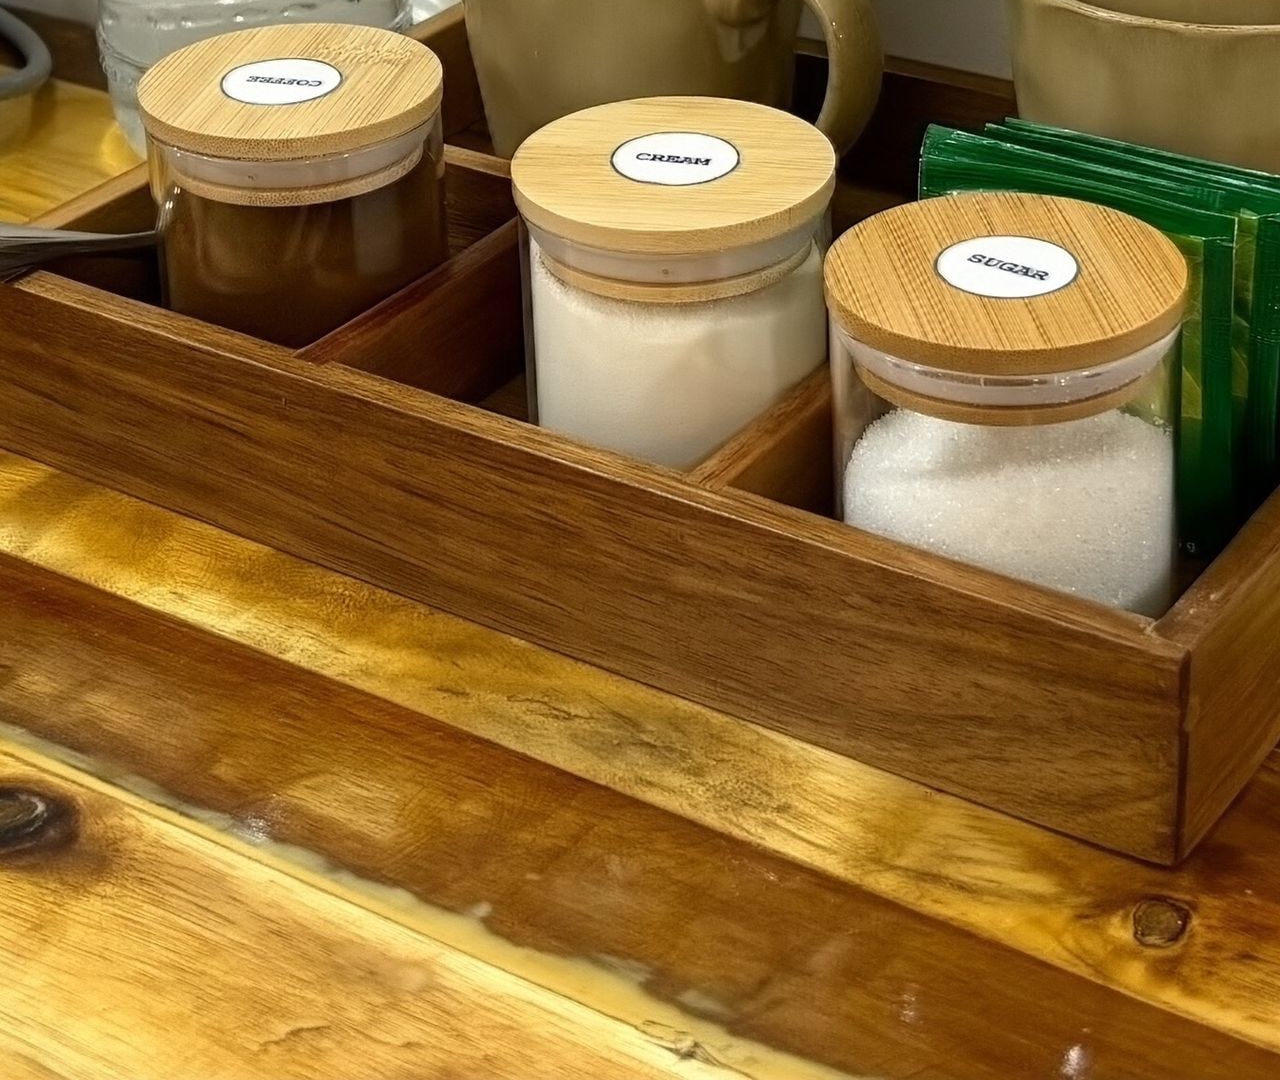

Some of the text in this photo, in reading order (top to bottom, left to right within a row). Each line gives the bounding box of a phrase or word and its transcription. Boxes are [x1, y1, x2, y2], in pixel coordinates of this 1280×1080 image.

[246, 75, 322, 88] COFFEE
[635, 152, 712, 167] CREAM
[967, 253, 1049, 281] SUGAR
